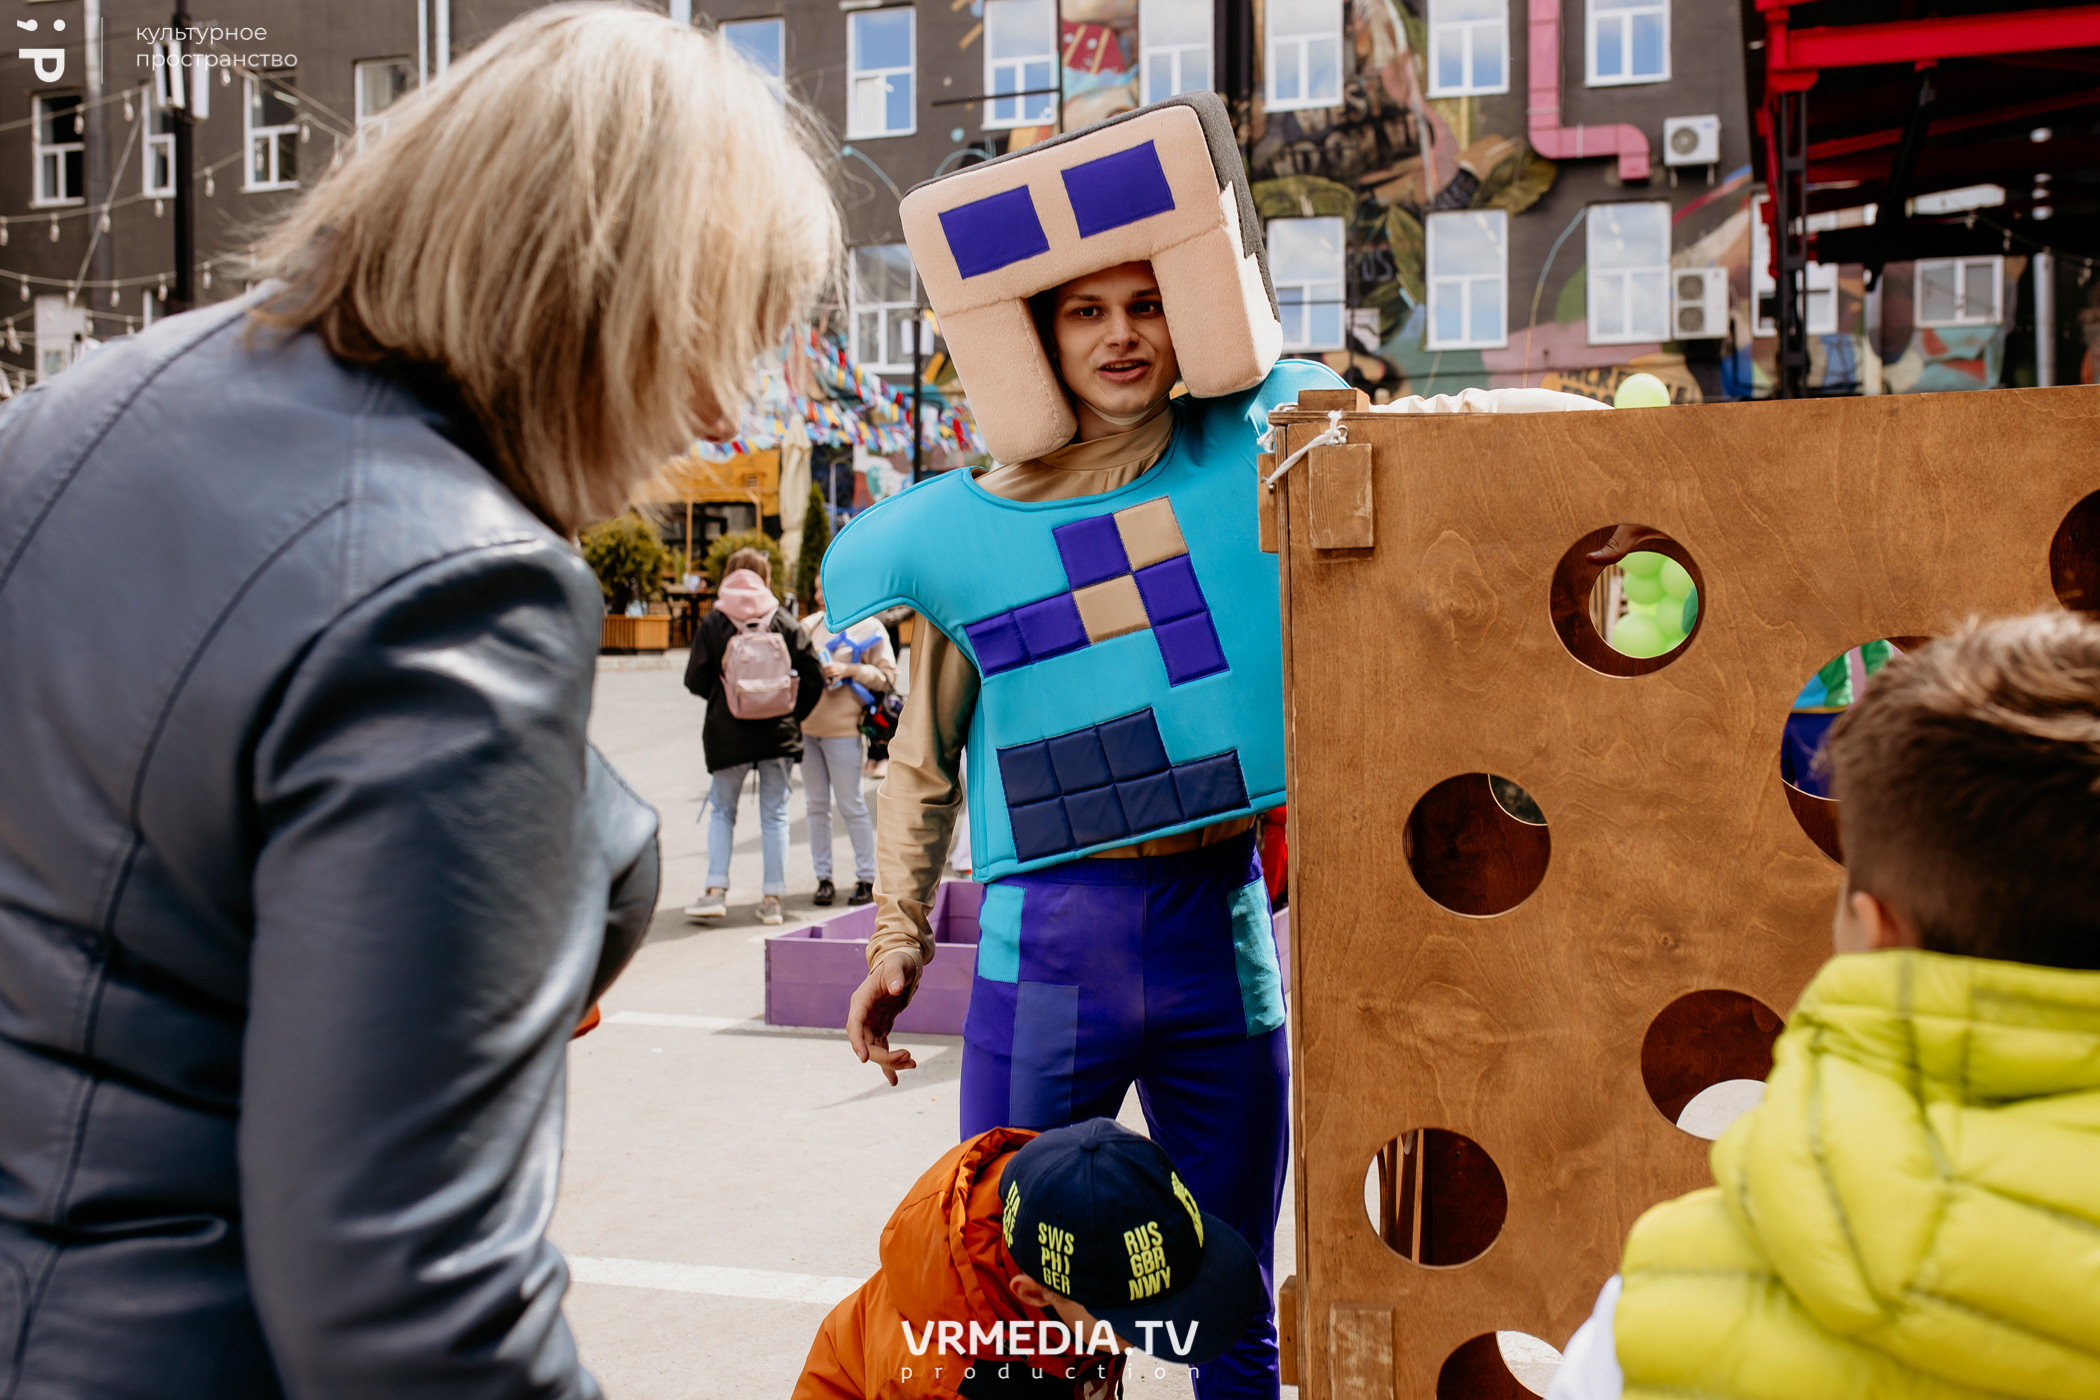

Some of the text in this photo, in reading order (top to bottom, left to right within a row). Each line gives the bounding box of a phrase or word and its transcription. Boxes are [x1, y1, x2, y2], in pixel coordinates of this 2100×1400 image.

[1038, 1221, 1074, 1255] SWS
[1123, 1220, 1163, 1256] RUS
[1041, 1245, 1070, 1275] PHI
[1129, 1246, 1166, 1278] GBR
[1043, 1266, 1070, 1295] GER
[1128, 1265, 1171, 1301] NWY
